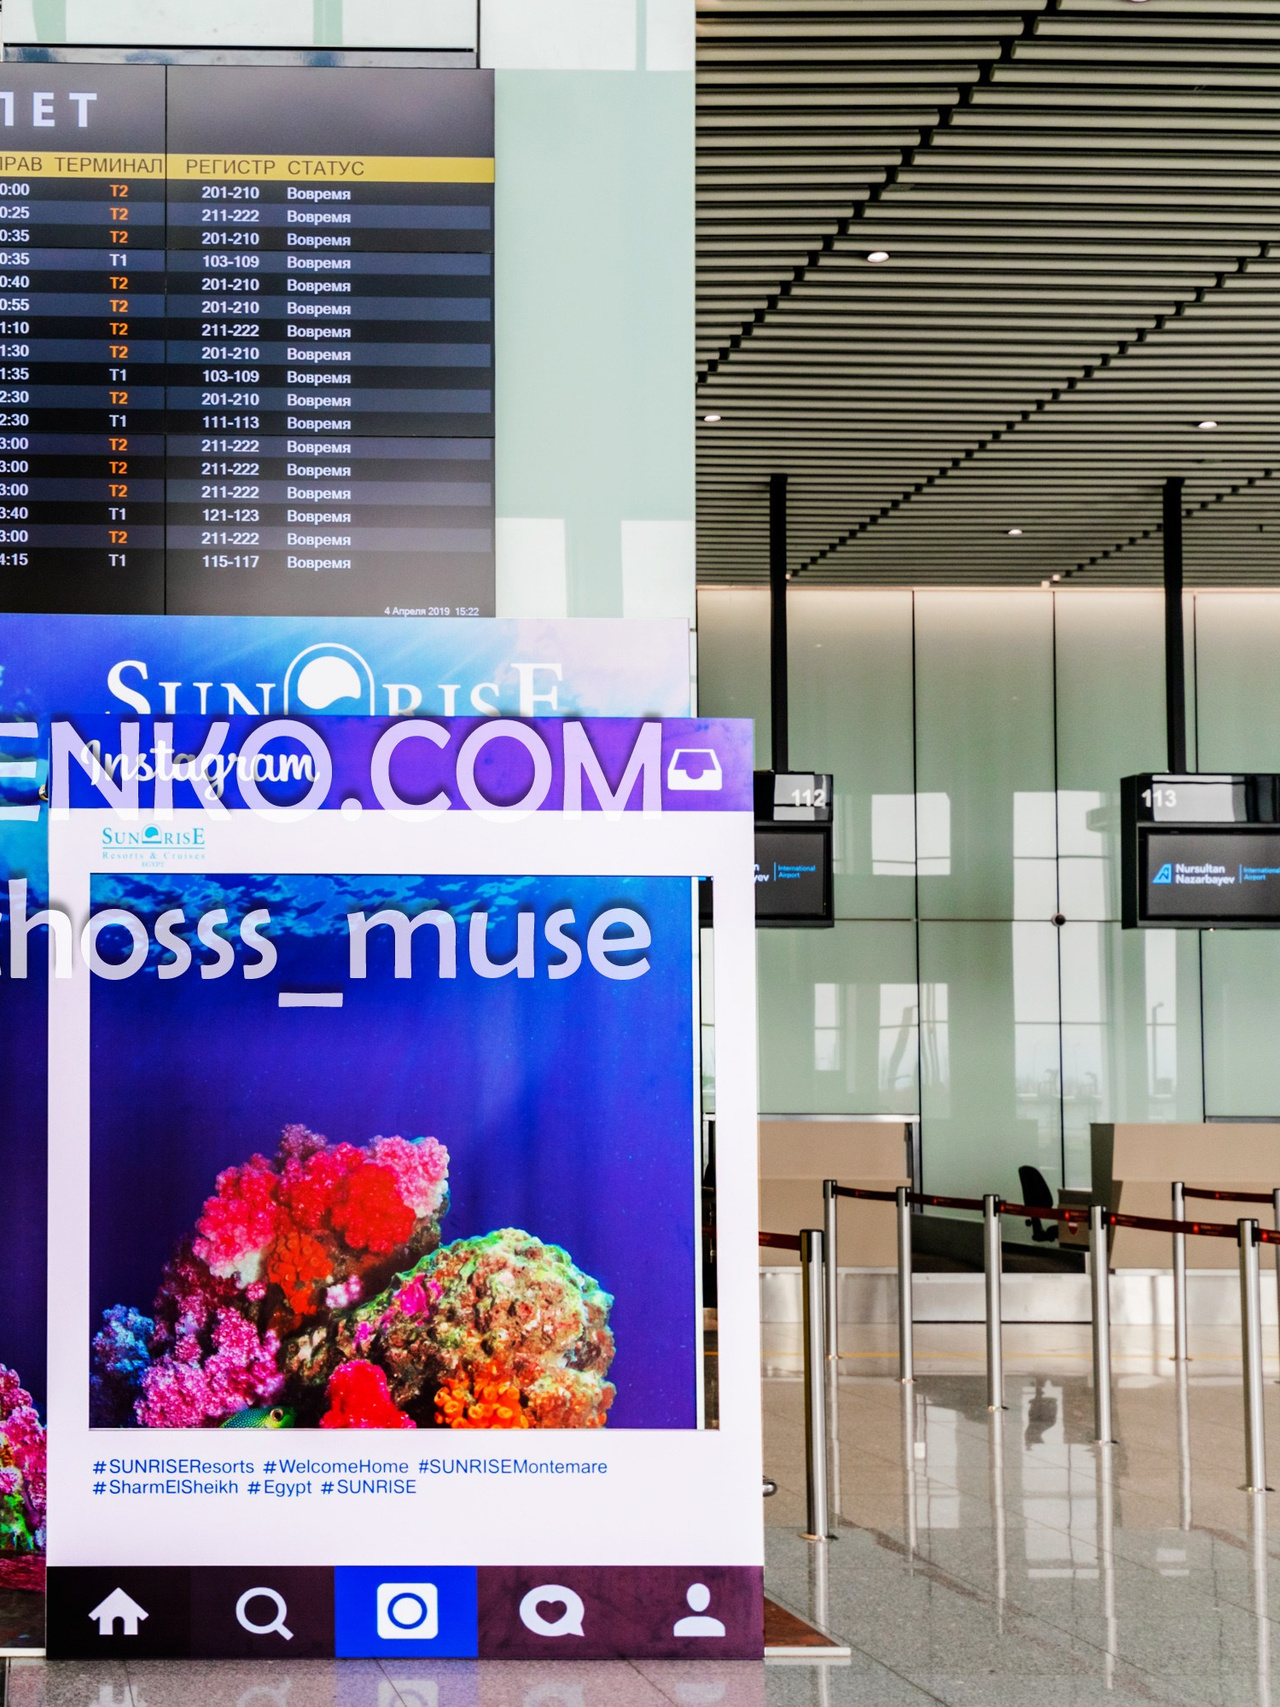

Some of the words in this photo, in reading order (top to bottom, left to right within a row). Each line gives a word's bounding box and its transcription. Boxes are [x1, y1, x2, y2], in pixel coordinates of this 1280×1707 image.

[55, 157, 162, 173] ТЕРМИНАЛ
[187, 160, 275, 174] РЕГИСТР
[288, 161, 364, 175] СТАТУС
[110, 185, 128, 197] T2
[202, 186, 259, 198] 201-210
[288, 187, 350, 202] Вовремя
[110, 254, 126, 266] T1
[203, 255, 259, 267] 103-109
[288, 256, 350, 271] Вовремя
[110, 323, 128, 335] T2
[202, 324, 259, 336] 211-222
[288, 325, 350, 340] Вовремя
[109, 369, 126, 381] T1
[203, 370, 259, 382] 103-109
[287, 371, 350, 386] Вовремя
[109, 415, 126, 427] T1
[203, 416, 259, 428] 111-113
[288, 417, 351, 432] Вовремя
[109, 508, 125, 520] T1
[203, 509, 259, 521] 121-123
[288, 510, 351, 525] Вовремя
[109, 554, 125, 566] T1
[203, 556, 259, 567] 115-117
[288, 556, 351, 571] Вовремя
[384, 607, 390, 615] 4
[392, 607, 426, 618] Апреля
[428, 607, 450, 616] 2019
[455, 607, 480, 616] 15:22
[81, 739, 321, 801] Instagram
[791, 789, 827, 808] 112
[1141, 789, 1177, 808] 113
[102, 852, 144, 860] Resorts
[149, 852, 157, 860] &
[163, 852, 206, 860] Cruises
[1175, 863, 1226, 873] Nursultan
[1175, 874, 1236, 886] Nazarbayev
[92, 1459, 255, 1474] #SUNRISEResorts
[263, 1459, 409, 1474] #WelcomeHome
[418, 1459, 608, 1474] #SUNRISEMontemare
[92, 1480, 239, 1494] #SharmElSheikh
[247, 1480, 313, 1498] #Egypt
[321, 1480, 417, 1494] #SUNRISE
